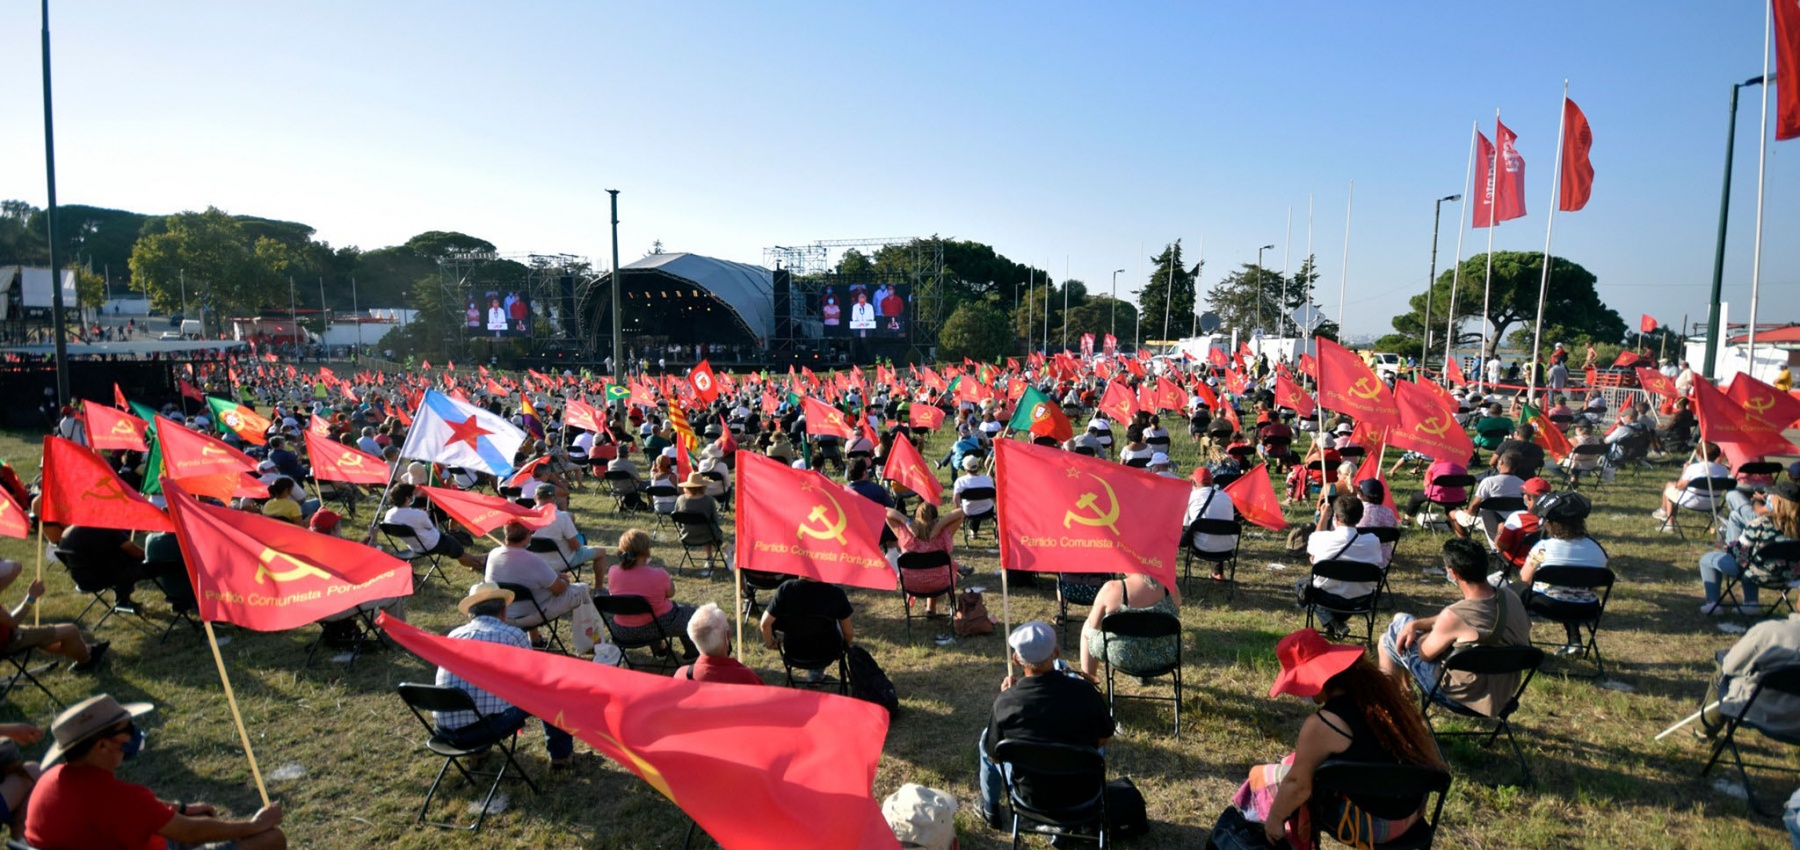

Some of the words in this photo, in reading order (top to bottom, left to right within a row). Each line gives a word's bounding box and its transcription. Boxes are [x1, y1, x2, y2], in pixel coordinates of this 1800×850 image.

[753, 540, 788, 553] Partido
[790, 545, 837, 562] Comunista
[839, 553, 886, 569] Português
[1020, 536, 1057, 548] Partido
[1060, 536, 1113, 548] Comunista
[1116, 541, 1163, 569] Português
[247, 588, 321, 608] Comunista
